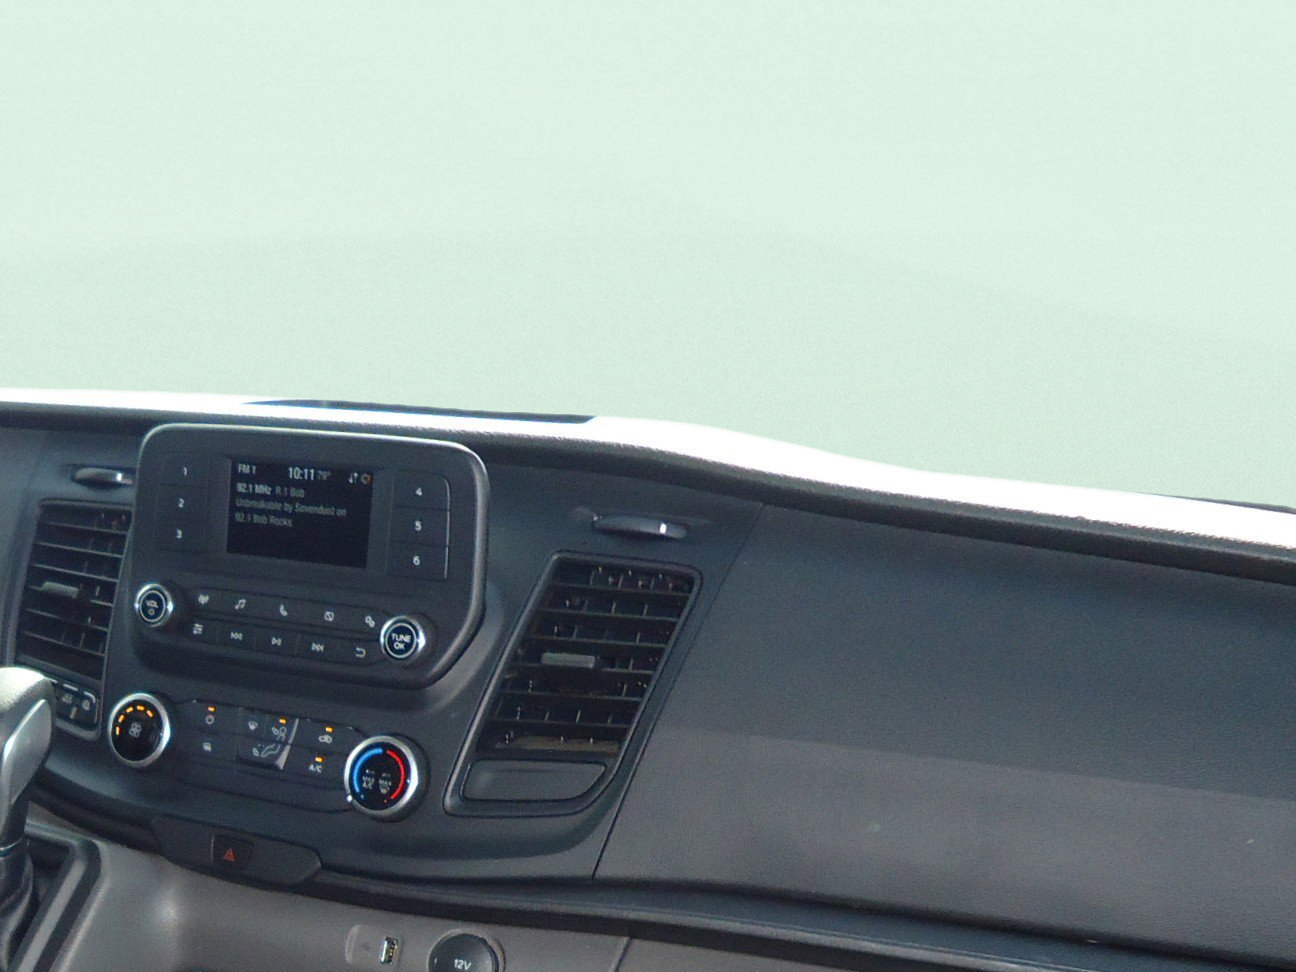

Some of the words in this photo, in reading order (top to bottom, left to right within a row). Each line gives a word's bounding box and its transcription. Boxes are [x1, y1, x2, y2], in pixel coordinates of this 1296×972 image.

[237, 463, 250, 475] FM
[288, 466, 315, 480] 10:11
[254, 484, 272, 495] MHz
[415, 487, 423, 496] 4
[178, 498, 185, 508] 2
[415, 520, 422, 531] 5
[176, 529, 183, 539] 3
[413, 555, 421, 566] 6
[391, 632, 412, 643] TUNE
[393, 641, 405, 650] OK
[309, 763, 323, 773] A/C
[454, 958, 472, 971] 12V
